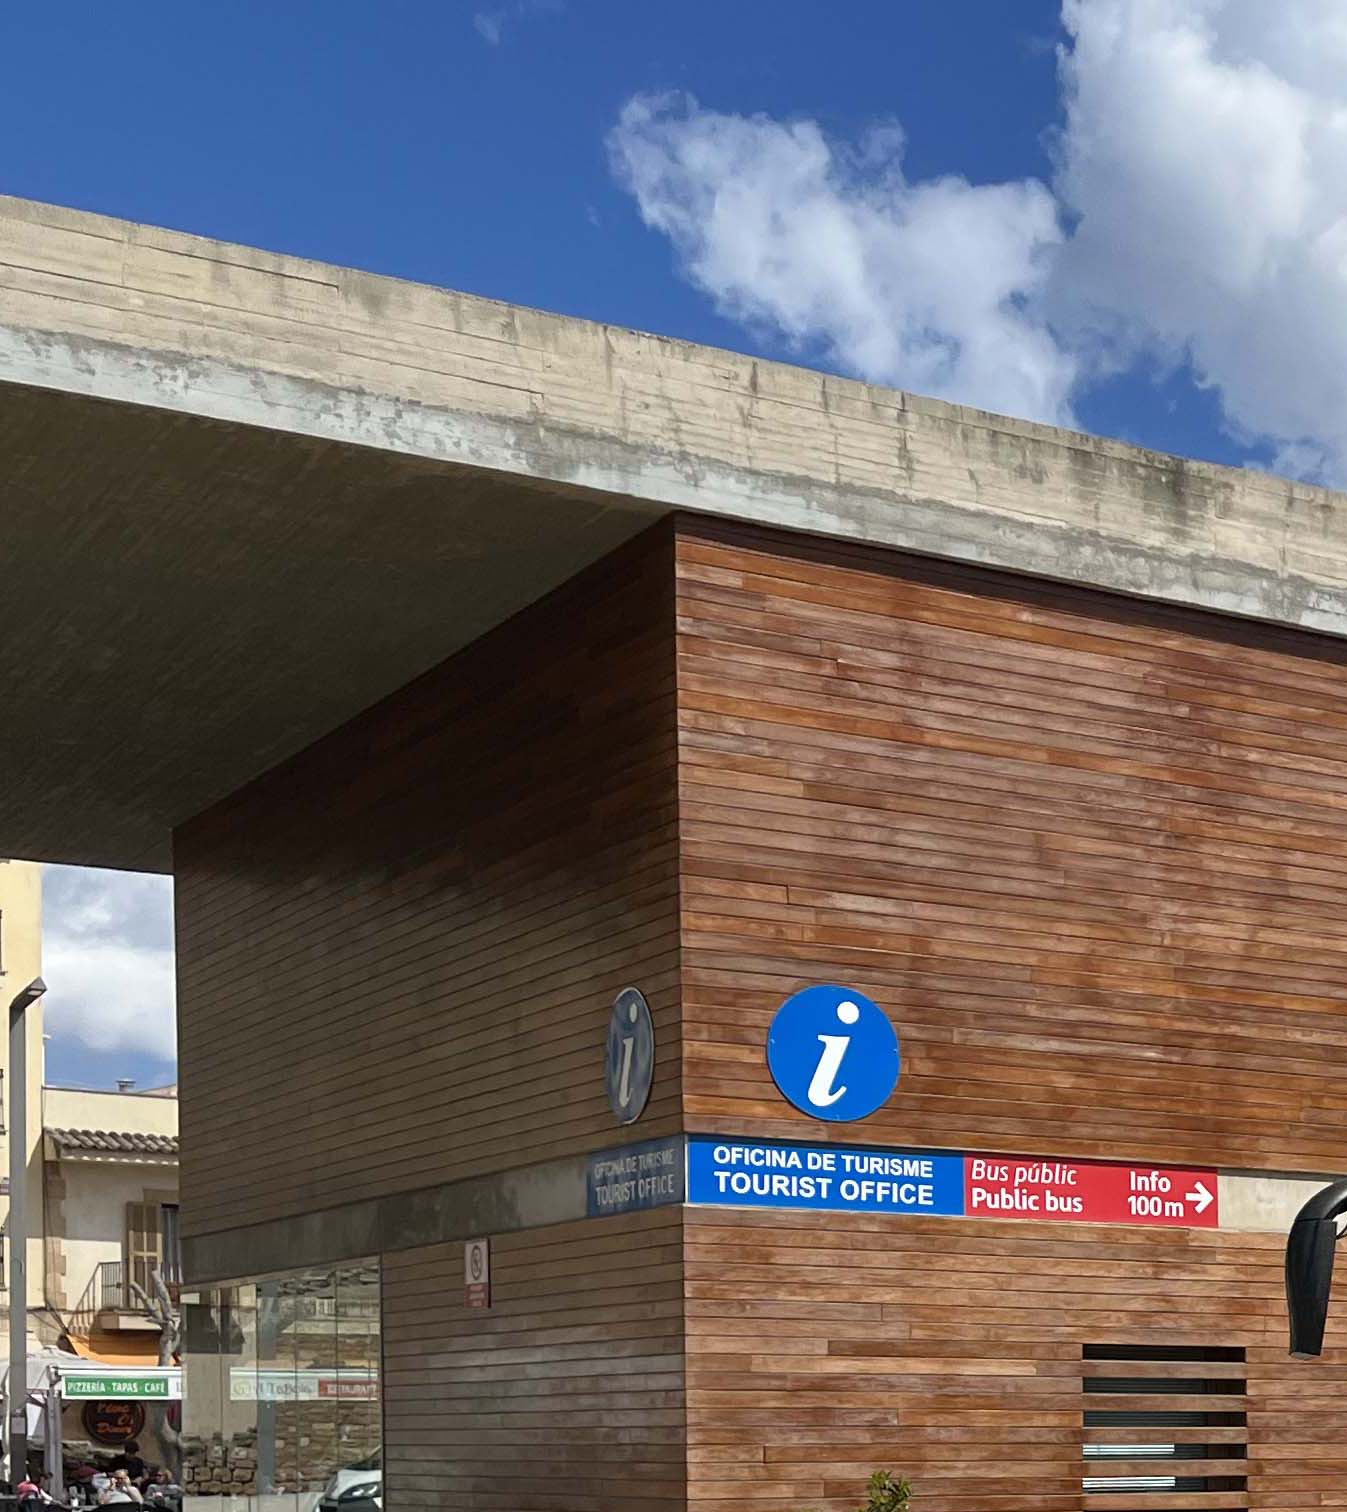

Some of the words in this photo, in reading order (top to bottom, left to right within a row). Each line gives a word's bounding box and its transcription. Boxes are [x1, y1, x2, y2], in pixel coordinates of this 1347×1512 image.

[594, 1160, 625, 1179] OFICINA
[626, 1156, 638, 1172] DE
[638, 1148, 675, 1170] TURISME
[714, 1146, 802, 1169] OFICINA
[808, 1153, 836, 1172] DE
[841, 1155, 933, 1178] TURISME
[971, 1159, 1009, 1182] Bus
[1014, 1162, 1078, 1186] públic
[595, 1180, 636, 1206] TOURIST
[638, 1174, 674, 1198] OFFICE
[714, 1171, 833, 1200] TOURIST
[840, 1180, 934, 1206] OFFICE
[1130, 1171, 1171, 1192] Info
[972, 1187, 1039, 1211] Public
[1045, 1191, 1083, 1213] bus
[111, 1381, 138, 1393] TAPAS
